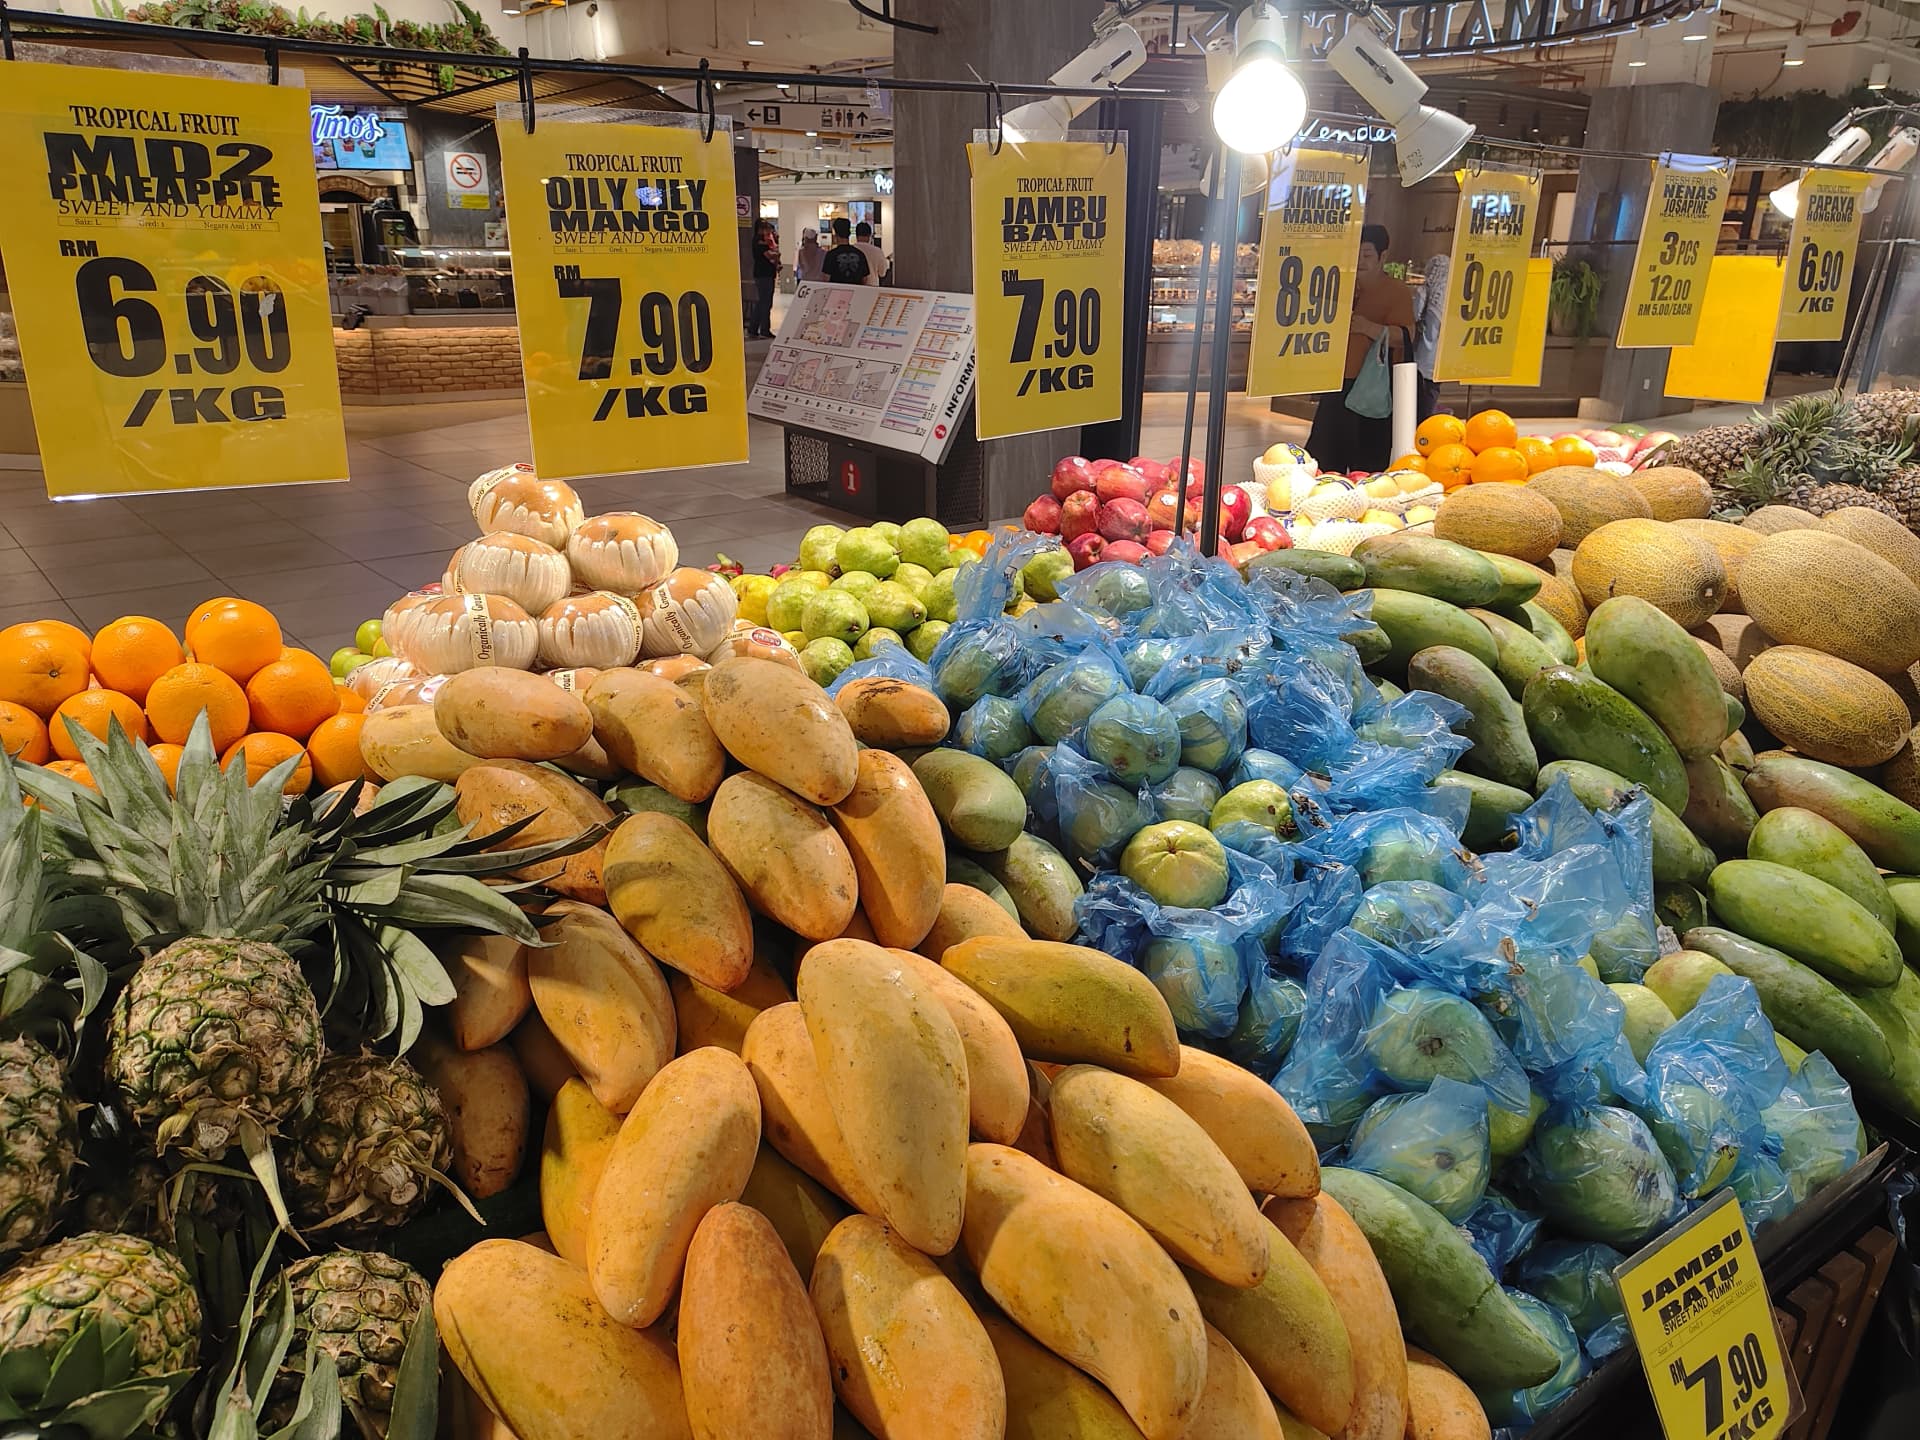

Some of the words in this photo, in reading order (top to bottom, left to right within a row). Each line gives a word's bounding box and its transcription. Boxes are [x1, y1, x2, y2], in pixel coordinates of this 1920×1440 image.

[70, 105, 177, 132] TROPICAL
[180, 112, 239, 136] FRUIT
[44, 132, 273, 181] MD2
[566, 154, 638, 172] TROPICAL
[640, 156, 682, 173] FRUIT
[48, 173, 282, 207] PINEAPPLE
[1017, 178, 1064, 192] TROPICAL
[1066, 178, 1094, 191] FRUIT
[1664, 184, 1718, 200] NENAS
[1665, 175, 1689, 184] FRESH
[546, 177, 627, 210] OILY
[638, 178, 707, 210] LILY
[1664, 199, 1708, 214] JOSAPINE
[1809, 195, 1854, 212] PAPAYA
[59, 200, 134, 216] SWEET
[142, 202, 188, 217] AND
[194, 204, 276, 220] YUMMY
[550, 210, 709, 232] MANGO
[1001, 196, 1106, 225] JAMBU
[1284, 209, 1350, 224] MANGO
[1807, 211, 1853, 222] HONGKONG
[554, 231, 607, 245] SWEET
[611, 232, 645, 244] AND
[650, 231, 707, 244] YUMMY
[1004, 222, 1106, 242] BATU
[59, 240, 99, 257] RM
[1004, 241, 1039, 253] SWEET
[1040, 240, 1063, 251] AND
[1067, 239, 1104, 249] YUMMY
[1280, 246, 1291, 256] RM
[554, 265, 580, 280] RM
[1002, 270, 1018, 282] RM
[1799, 243, 1844, 292] 6.90
[1276, 256, 1340, 327] 8.90
[1461, 261, 1513, 321] 9.90
[1650, 275, 1691, 301] 12.00
[76, 256, 291, 377] 6.90
[1638, 304, 1651, 316] RM
[1652, 304, 1692, 316] 5.00/EACH
[1799, 297, 1834, 313] /KG
[558, 278, 713, 380] 7.90
[1004, 279, 1100, 364] 7.90
[1278, 331, 1330, 357] /KG
[1461, 326, 1503, 346] /KG
[944, 347, 976, 418] INFORMA
[1016, 364, 1094, 397] /KG
[124, 386, 286, 428] /KG
[593, 384, 708, 421] /KG
[477, 615, 492, 660] Organically
[665, 611, 693, 649] Organically
[1642, 1229, 1743, 1312] JAMBU
[1659, 1257, 1739, 1323] BATU
[1664, 1308, 1691, 1335] SWEET
[1692, 1296, 1709, 1316] AND
[1669, 1357, 1686, 1386] RM
[1682, 1333, 1768, 1436] 7.90
